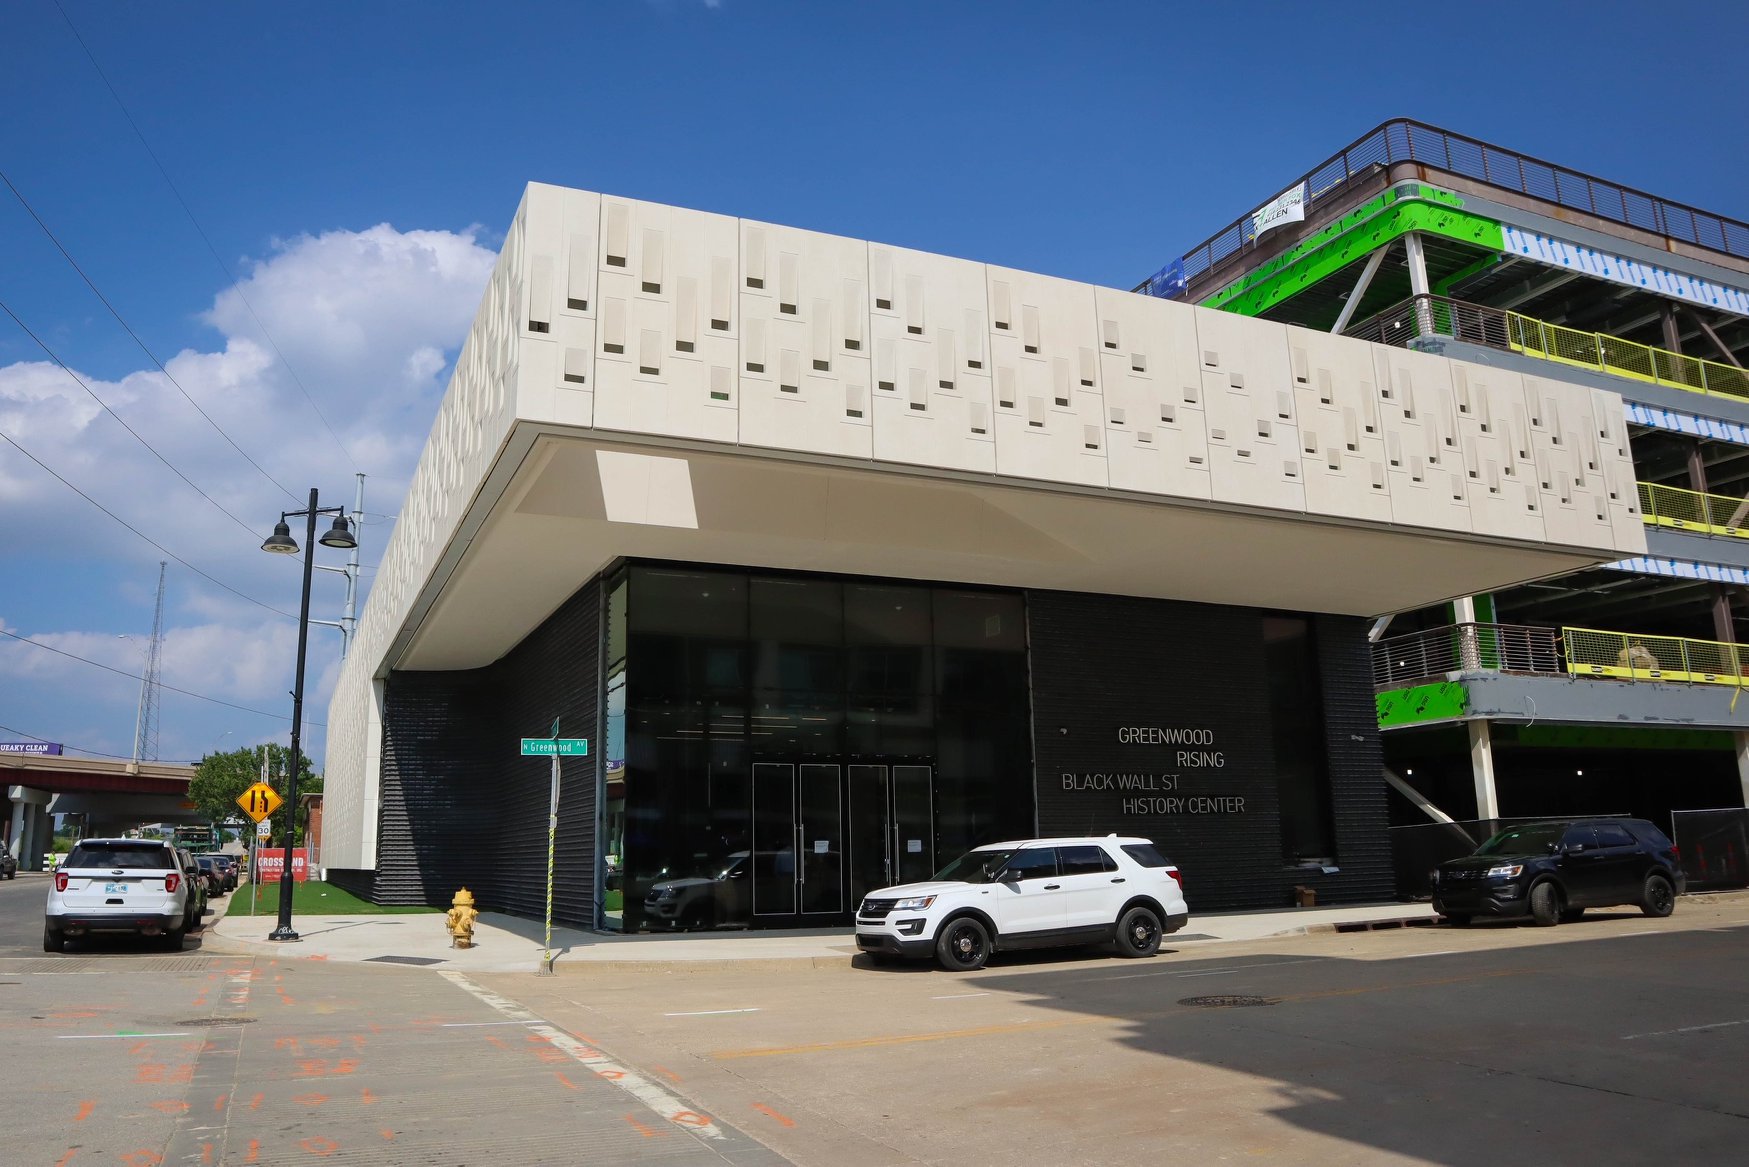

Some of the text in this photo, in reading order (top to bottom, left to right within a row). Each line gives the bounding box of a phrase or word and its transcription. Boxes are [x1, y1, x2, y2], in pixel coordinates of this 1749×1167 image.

[1264, 208, 1288, 224] ALLEN
[1118, 727, 1214, 745] GREENWOOD
[530, 742, 572, 752] Greenwood
[1176, 751, 1225, 768] RISING
[1062, 773, 1180, 790] BLACK WALL ST
[1122, 797, 1246, 814] HISTORY CENTER
[258, 857, 304, 867] CROSSND
